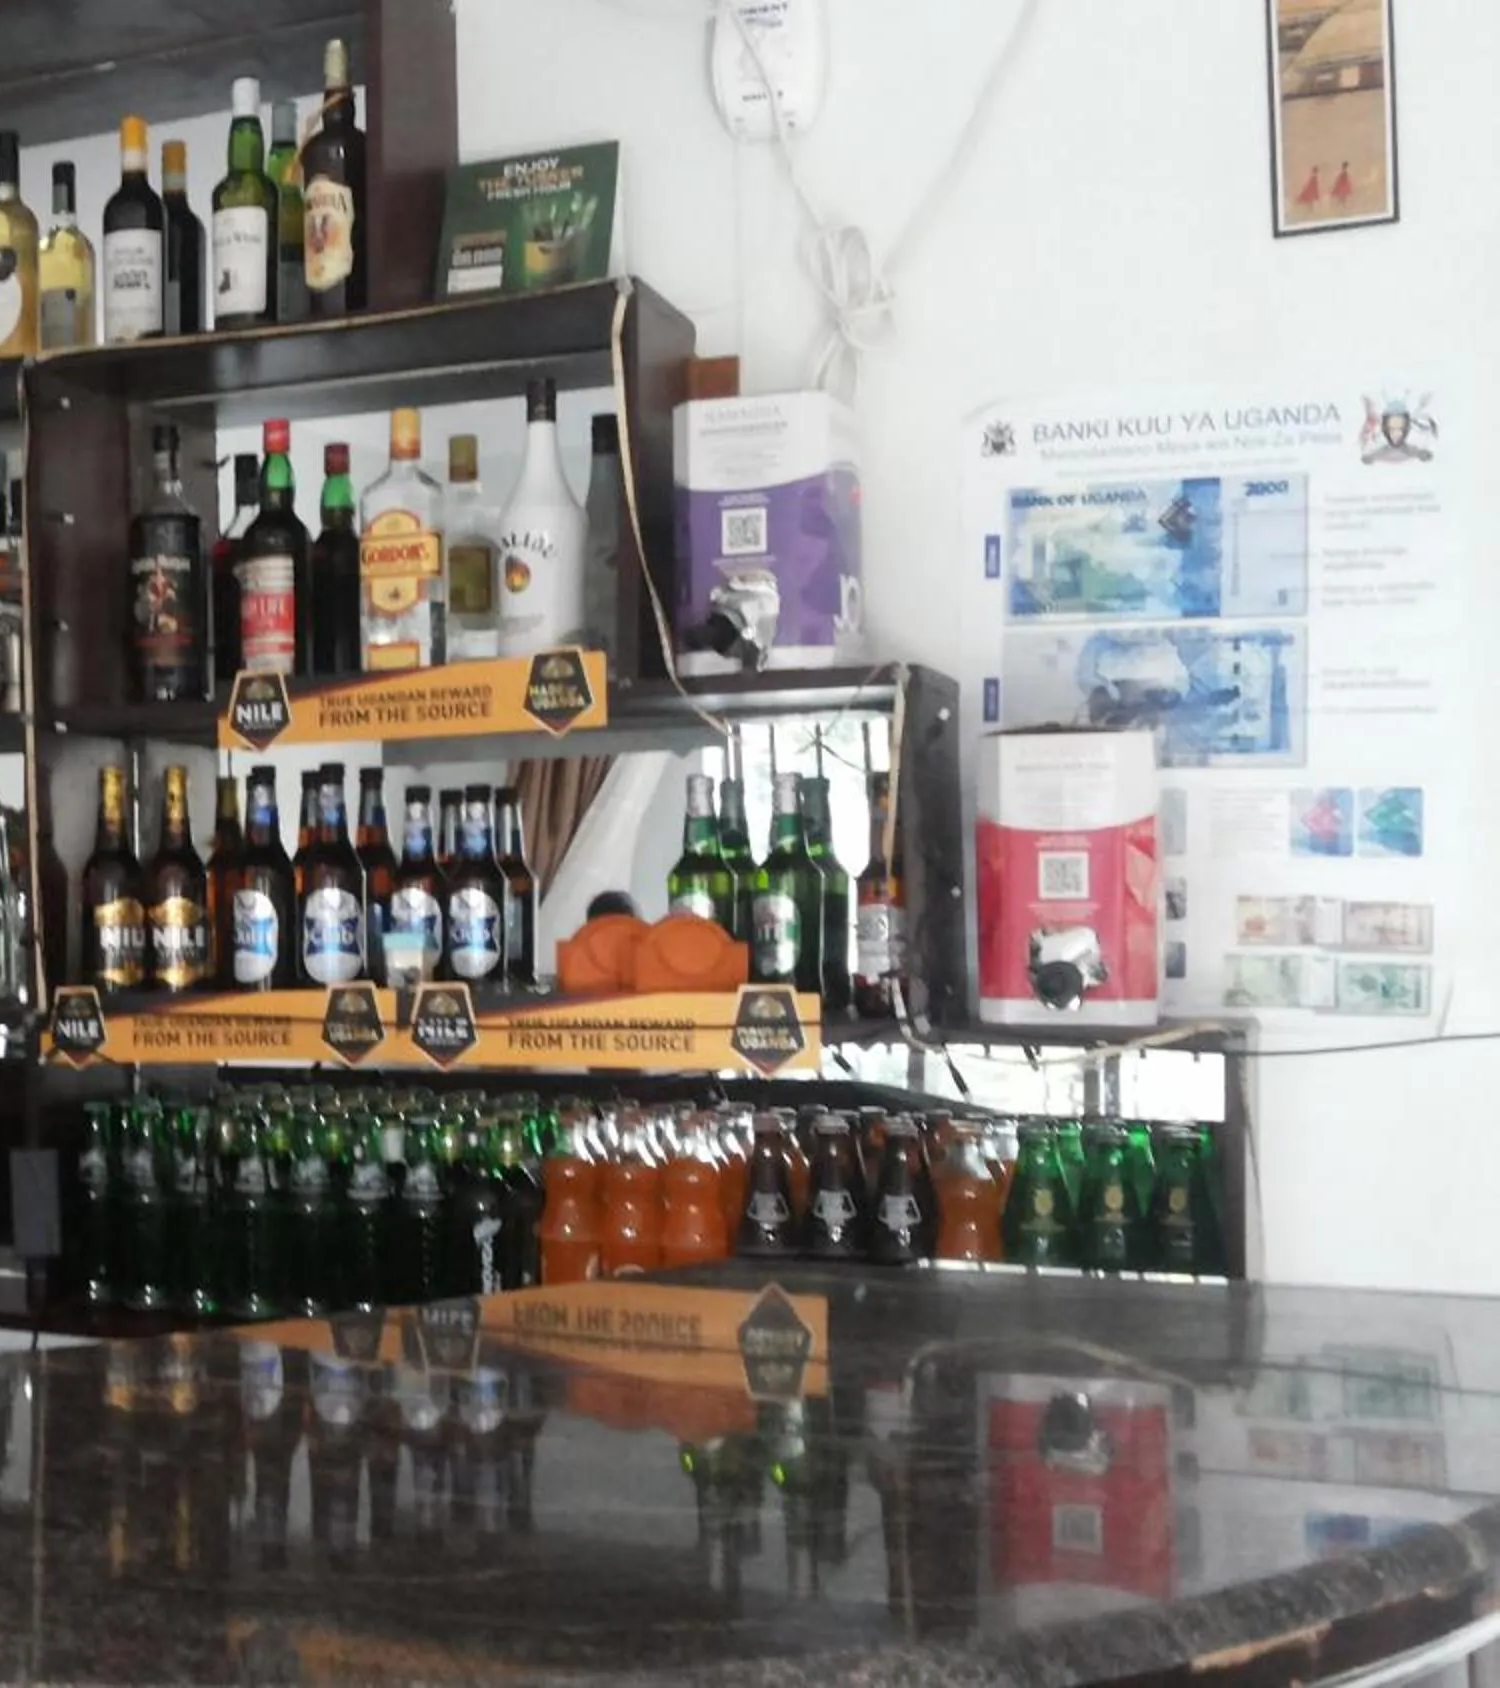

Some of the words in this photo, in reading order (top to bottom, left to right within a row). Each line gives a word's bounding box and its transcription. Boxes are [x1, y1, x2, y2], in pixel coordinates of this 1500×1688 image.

[1032, 417, 1110, 444] BANKI
[1116, 410, 1172, 437] KUU
[1180, 408, 1217, 433] YA
[1224, 401, 1342, 430] UGANDA
[235, 699, 283, 724] NILE
[318, 707, 372, 729] FROM
[376, 705, 410, 724] THE
[416, 699, 492, 721] SOURCE
[57, 1019, 99, 1040] NILE
[132, 1029, 182, 1049] FROM
[186, 1028, 218, 1047] THE
[223, 1026, 293, 1047] SOURCE
[507, 1033, 565, 1050] FROM
[571, 1032, 607, 1050] THE
[613, 1033, 696, 1053] SOURCE
